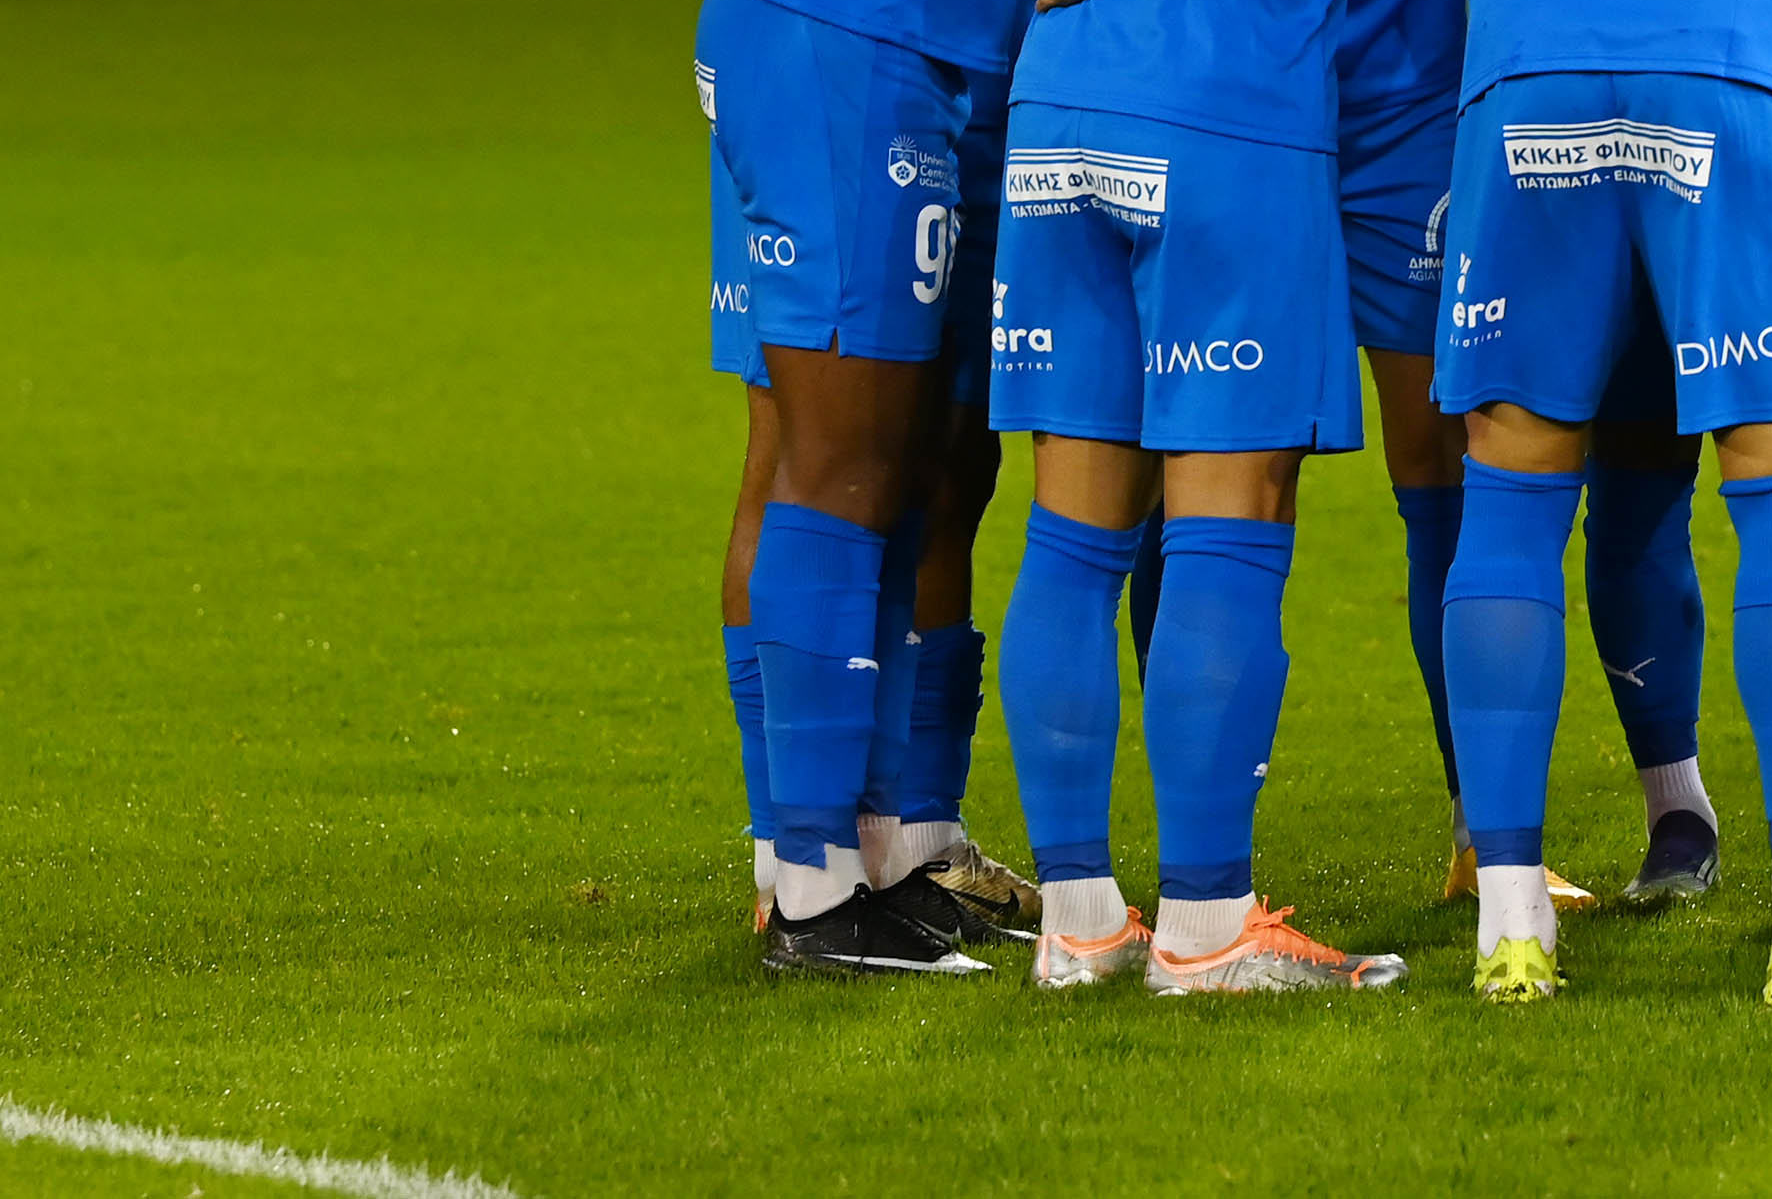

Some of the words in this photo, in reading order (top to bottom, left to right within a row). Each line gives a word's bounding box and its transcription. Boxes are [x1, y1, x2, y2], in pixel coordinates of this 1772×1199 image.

[912, 204, 961, 304] 9
[1452, 297, 1506, 329] era
[991, 326, 1053, 352] era
